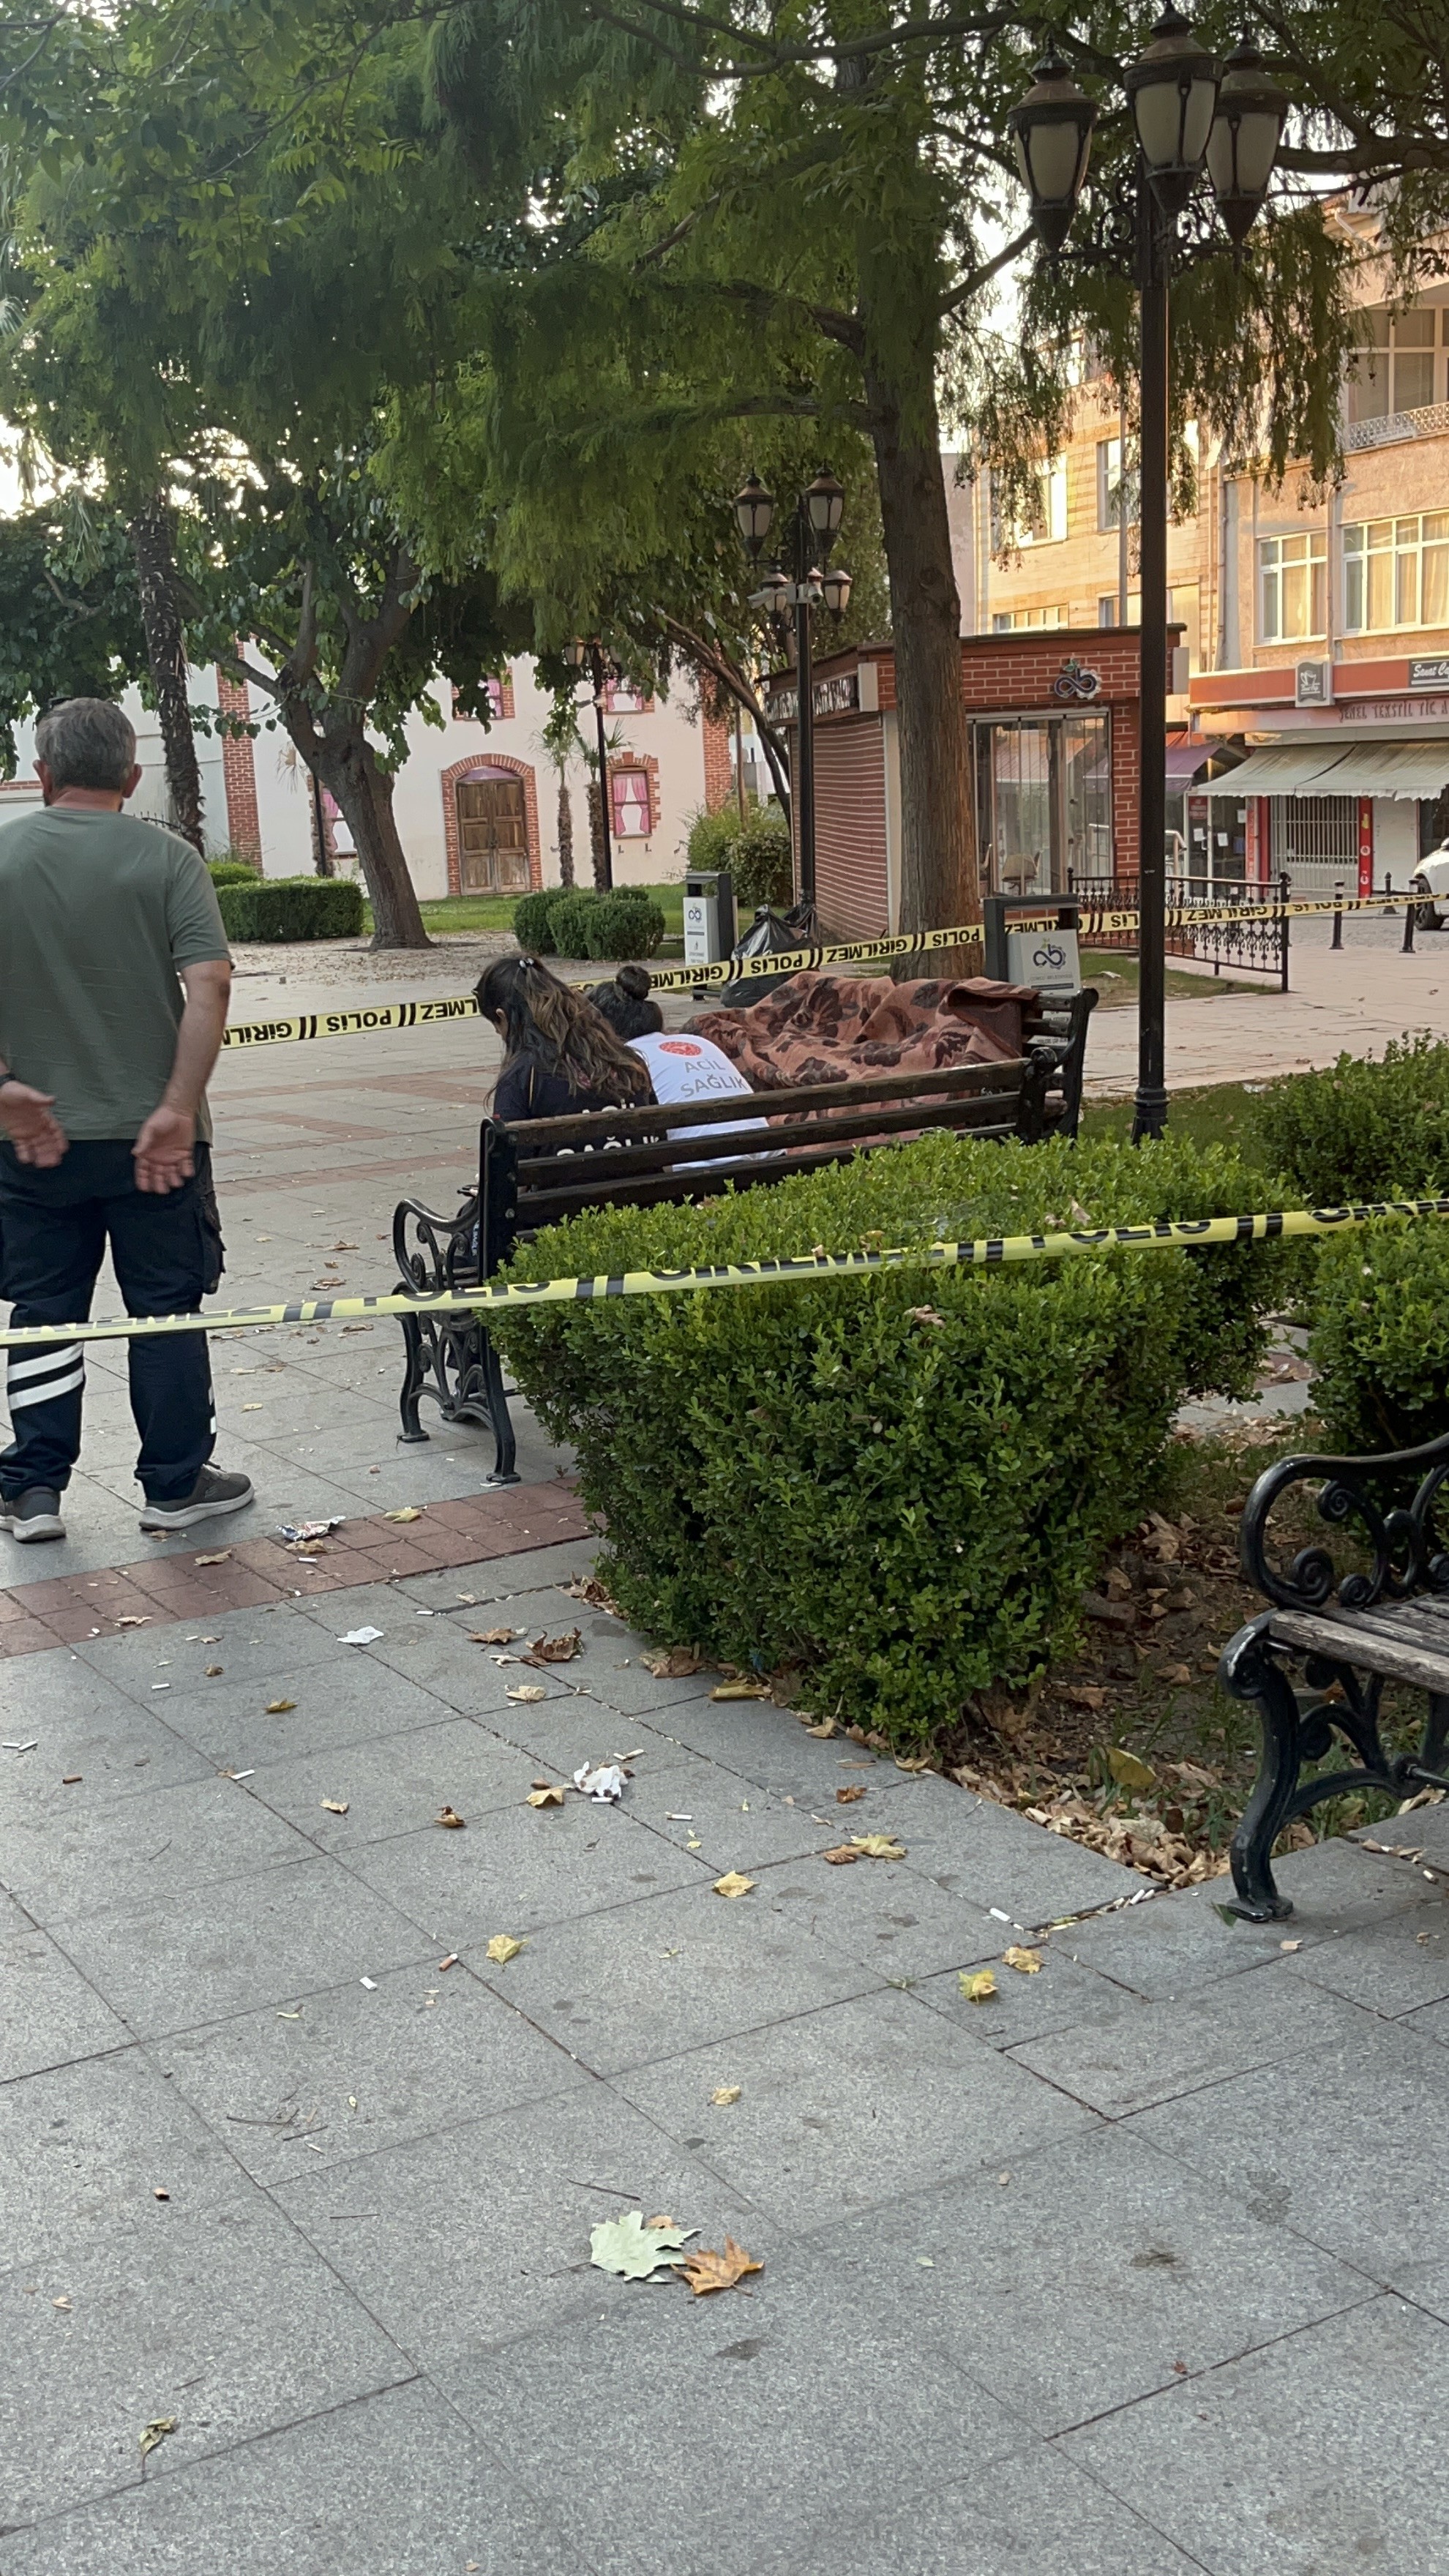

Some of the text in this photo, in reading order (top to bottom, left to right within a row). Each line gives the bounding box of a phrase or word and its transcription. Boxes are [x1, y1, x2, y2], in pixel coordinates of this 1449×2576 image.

[933, 928, 980, 947] POLİS
[827, 938, 907, 963] GİRİLMEZ
[750, 954, 803, 974] POLİS
[650, 964, 723, 989] GİRİLME
[326, 1009, 392, 1032] POLİS
[684, 1059, 726, 1073] ACİL
[681, 1074, 748, 1098] SAĞLIK
